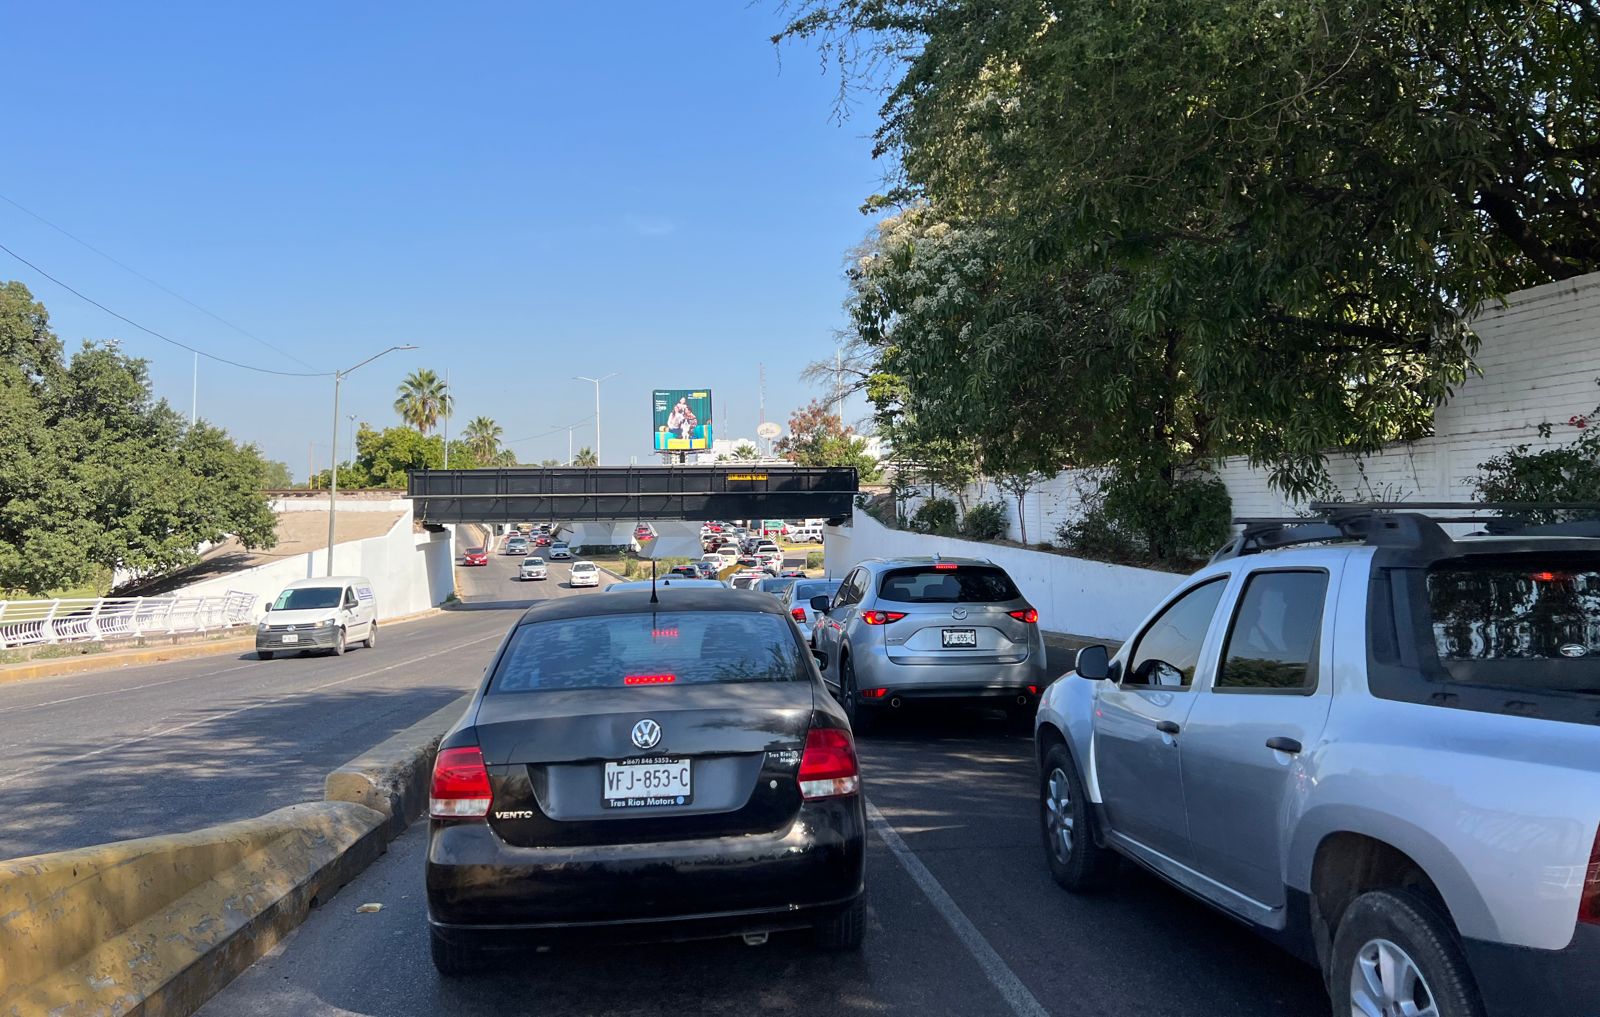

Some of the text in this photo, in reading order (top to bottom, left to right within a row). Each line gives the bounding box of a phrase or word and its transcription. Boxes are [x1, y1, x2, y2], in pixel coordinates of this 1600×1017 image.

[607, 768, 688, 791] VFJ-853-C
[610, 800, 626, 808] Tres
[646, 798, 675, 806] Motors
[495, 810, 533, 819] VENTO
